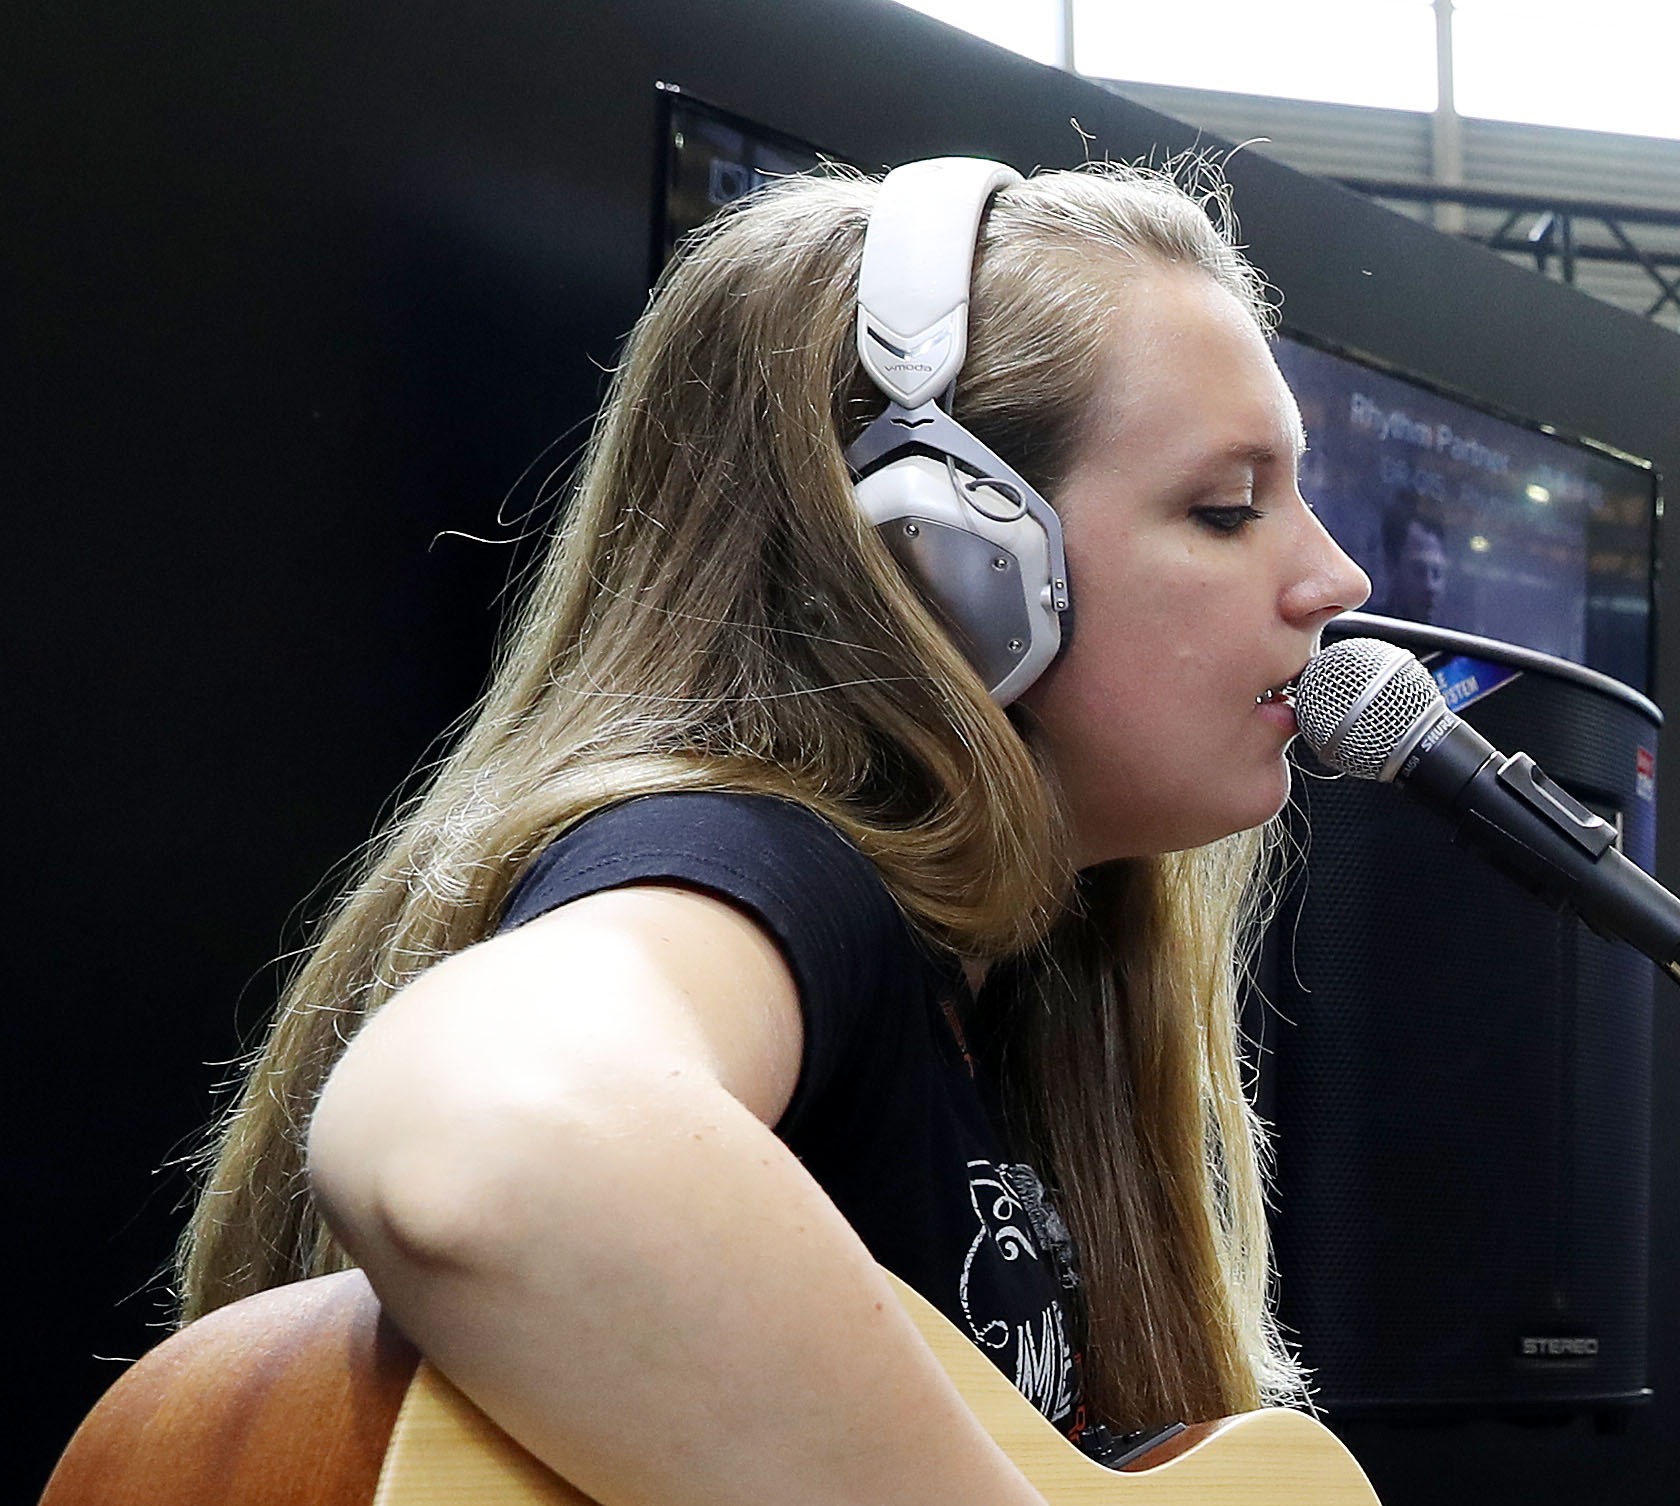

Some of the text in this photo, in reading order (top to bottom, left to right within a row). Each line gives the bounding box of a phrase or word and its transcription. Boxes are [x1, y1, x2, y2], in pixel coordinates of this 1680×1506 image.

[884, 363, 934, 373] v-moda
[1421, 714, 1455, 753] SHURE
[1522, 1337, 1600, 1355] STEREO
